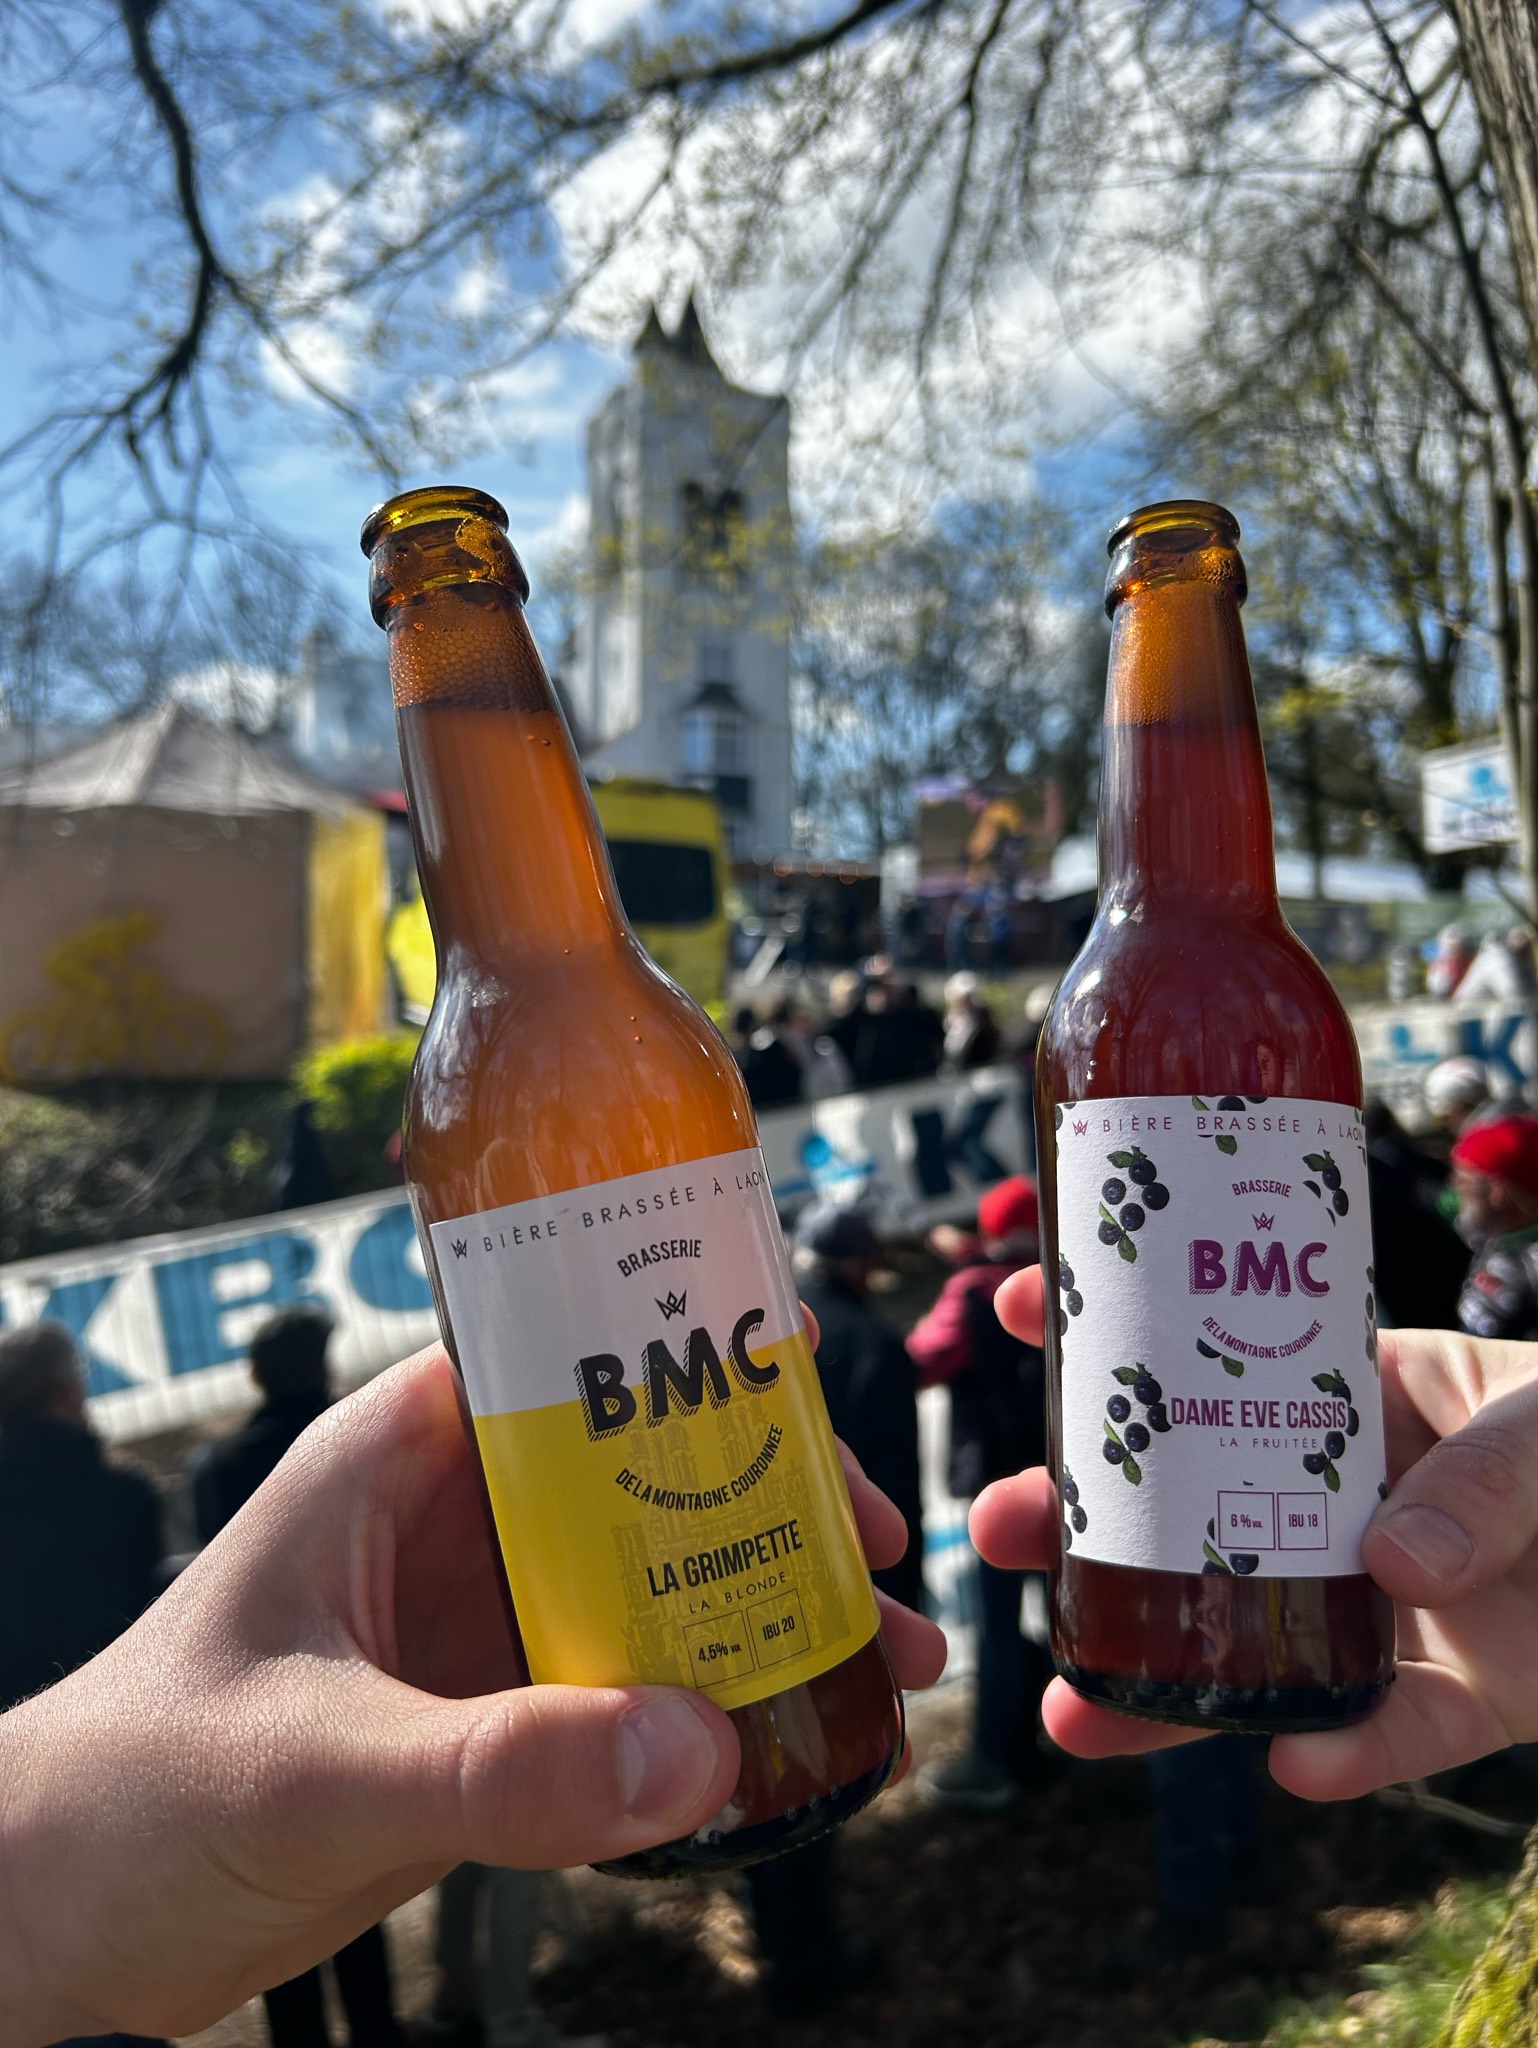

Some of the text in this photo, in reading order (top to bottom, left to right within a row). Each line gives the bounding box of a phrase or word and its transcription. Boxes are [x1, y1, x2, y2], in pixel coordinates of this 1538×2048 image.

[1103, 1114, 1172, 1133] BIÈRE
[1197, 1115, 1300, 1133] BRASSÉE
[1317, 1118, 1326, 1135] À
[1231, 1179, 1292, 1198] BRASSERIE
[485, 1221, 558, 1252] BIÈRE
[583, 1187, 696, 1228] BRASSÉE
[713, 1177, 724, 1195] À
[617, 1239, 702, 1277] BRASSERIE
[1188, 1239, 1331, 1298] BMC
[1224, 1334, 1278, 1359] MONTAGNE
[574, 1308, 780, 1442] BMC
[1171, 1397, 1347, 1428] DAME EVE CASSIS
[1219, 1436, 1318, 1449] LA FRUITÉE
[651, 1485, 732, 1511] MONTAGNE
[1288, 1514, 1318, 1528] IBU 18
[647, 1519, 803, 1597] LA GRIMPETTE
[688, 1571, 787, 1614] LA BLONDE
[762, 1615, 795, 1641] IBU 20
[698, 1641, 728, 1662] 4,5%
